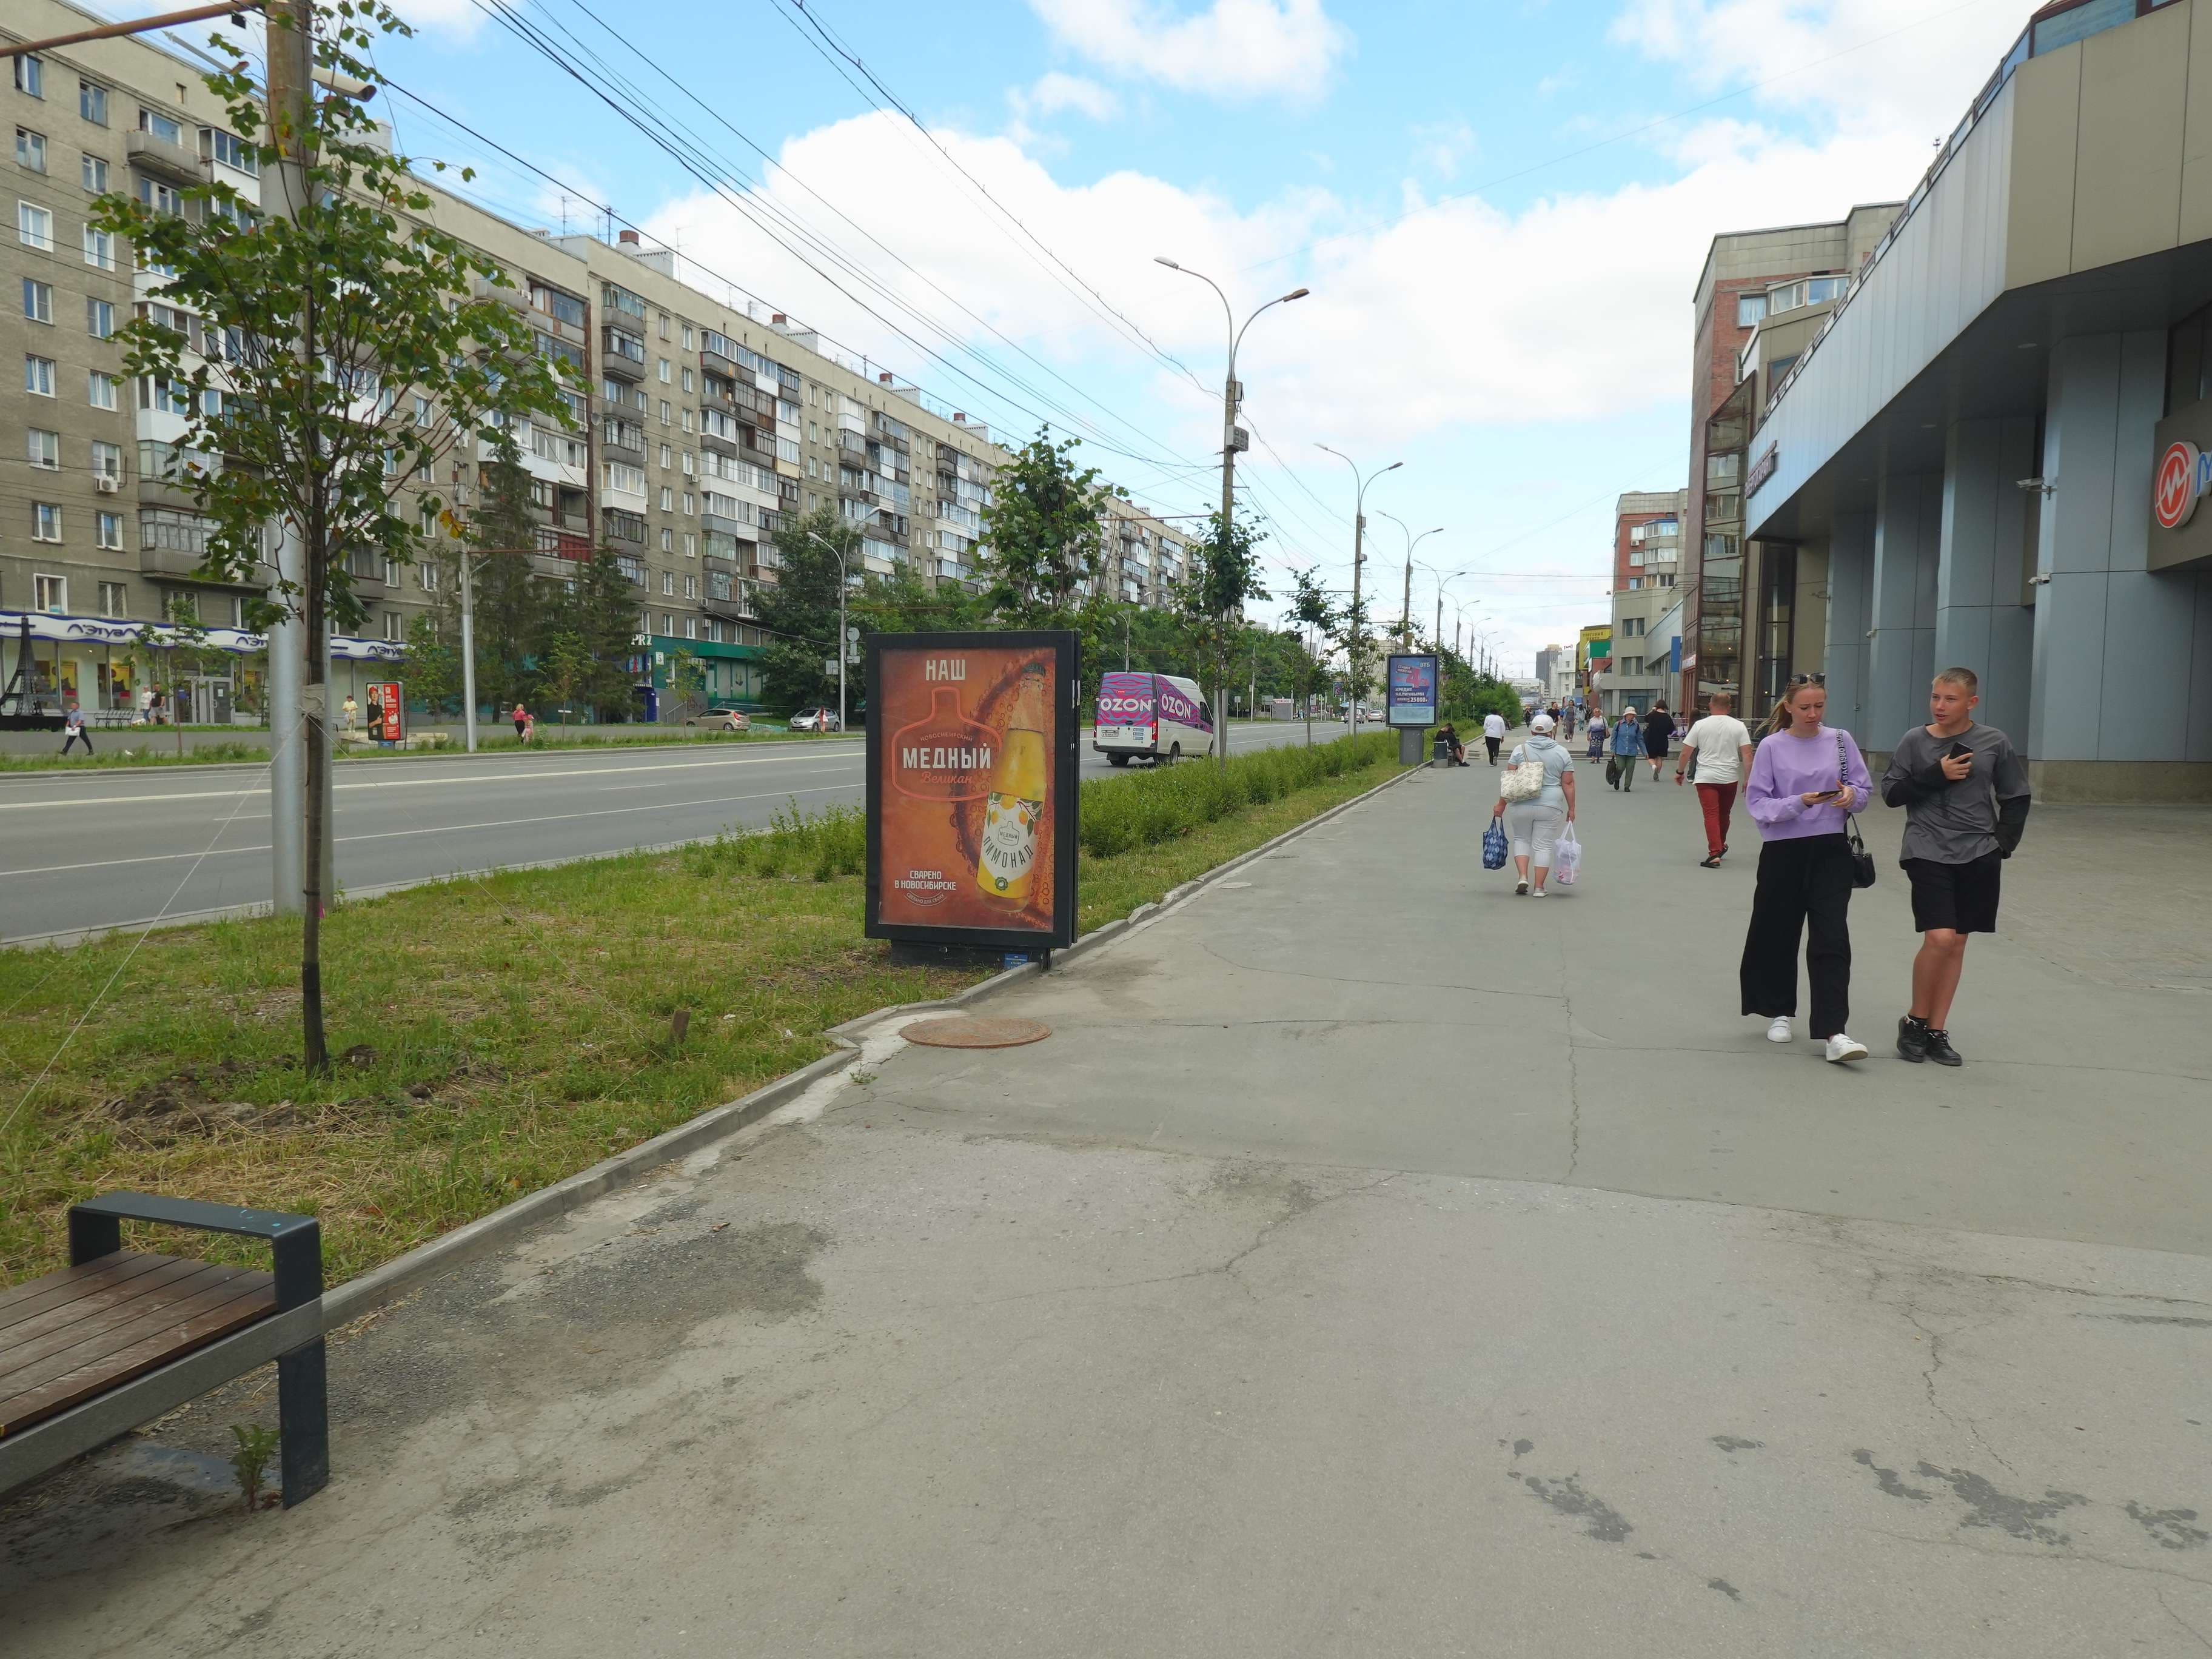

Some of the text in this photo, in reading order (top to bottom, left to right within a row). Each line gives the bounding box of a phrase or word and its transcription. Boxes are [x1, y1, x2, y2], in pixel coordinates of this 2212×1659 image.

[926, 659, 965, 681] НАШ
[1101, 698, 1151, 712] OZON
[1162, 693, 1191, 720] OZON
[920, 732, 973, 743] НОВОСИБИРСКИЙ
[903, 742, 991, 769] МЕДНЫЙ
[921, 771, 973, 783] Великан
[910, 870, 942, 880] СВАРЕНО
[894, 880, 956, 891] В НОВОСИБИРСКЕ
